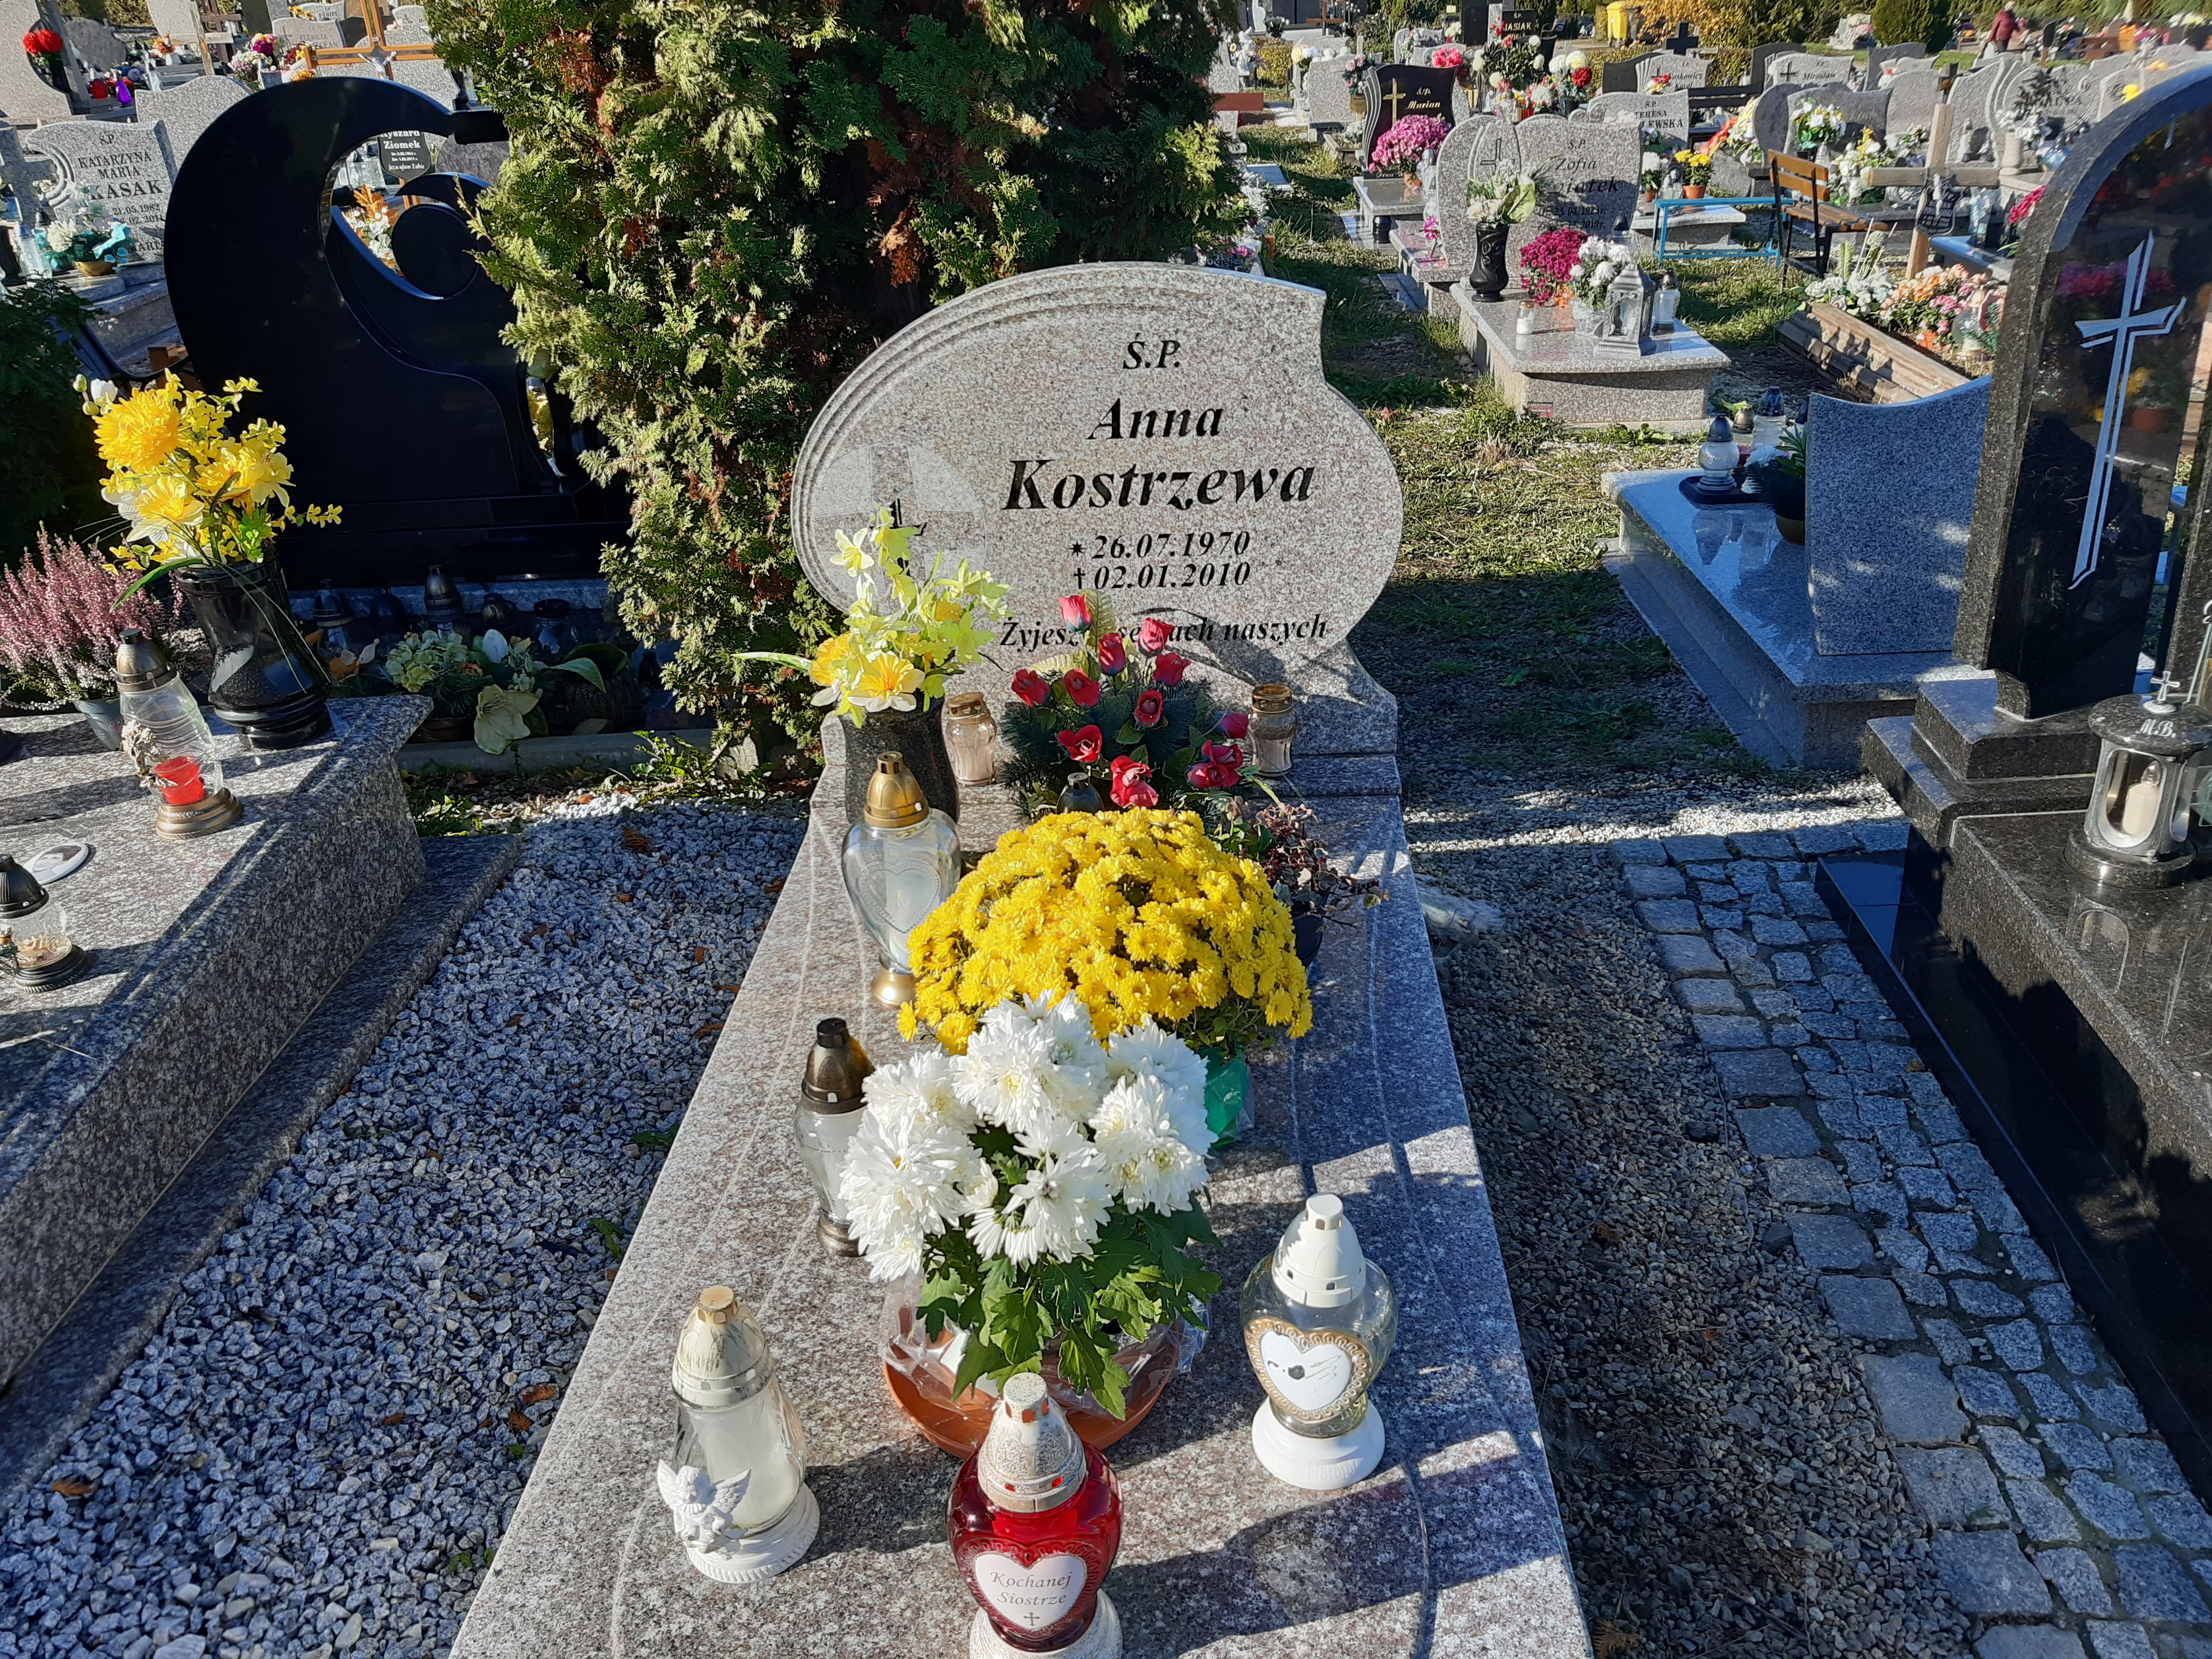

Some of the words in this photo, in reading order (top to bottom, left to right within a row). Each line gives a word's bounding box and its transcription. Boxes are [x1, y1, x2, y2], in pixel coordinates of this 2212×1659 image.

[1405, 100, 1441, 109] Marian
[1634, 110, 1667, 119] TERESA
[1641, 119, 1683, 129] LEWSKA
[384, 140, 421, 149] Ziomek
[77, 150, 152, 168] KATARZYNA
[1555, 156, 1597, 174] Zofia
[97, 165, 141, 179] MARIA
[1123, 332, 1180, 369] Ś.P.
[1085, 397, 1224, 440] Anna
[1001, 458, 1315, 511] Kostrzewa
[1091, 530, 1250, 559] 26.07.1970
[1094, 561, 1250, 589] 02.01.2010
[1223, 613, 1327, 647] naszych
[2134, 718, 2176, 738] M.B.
[990, 1571, 1073, 1590] Kochanej
[996, 1591, 1067, 1606] Siostrze
